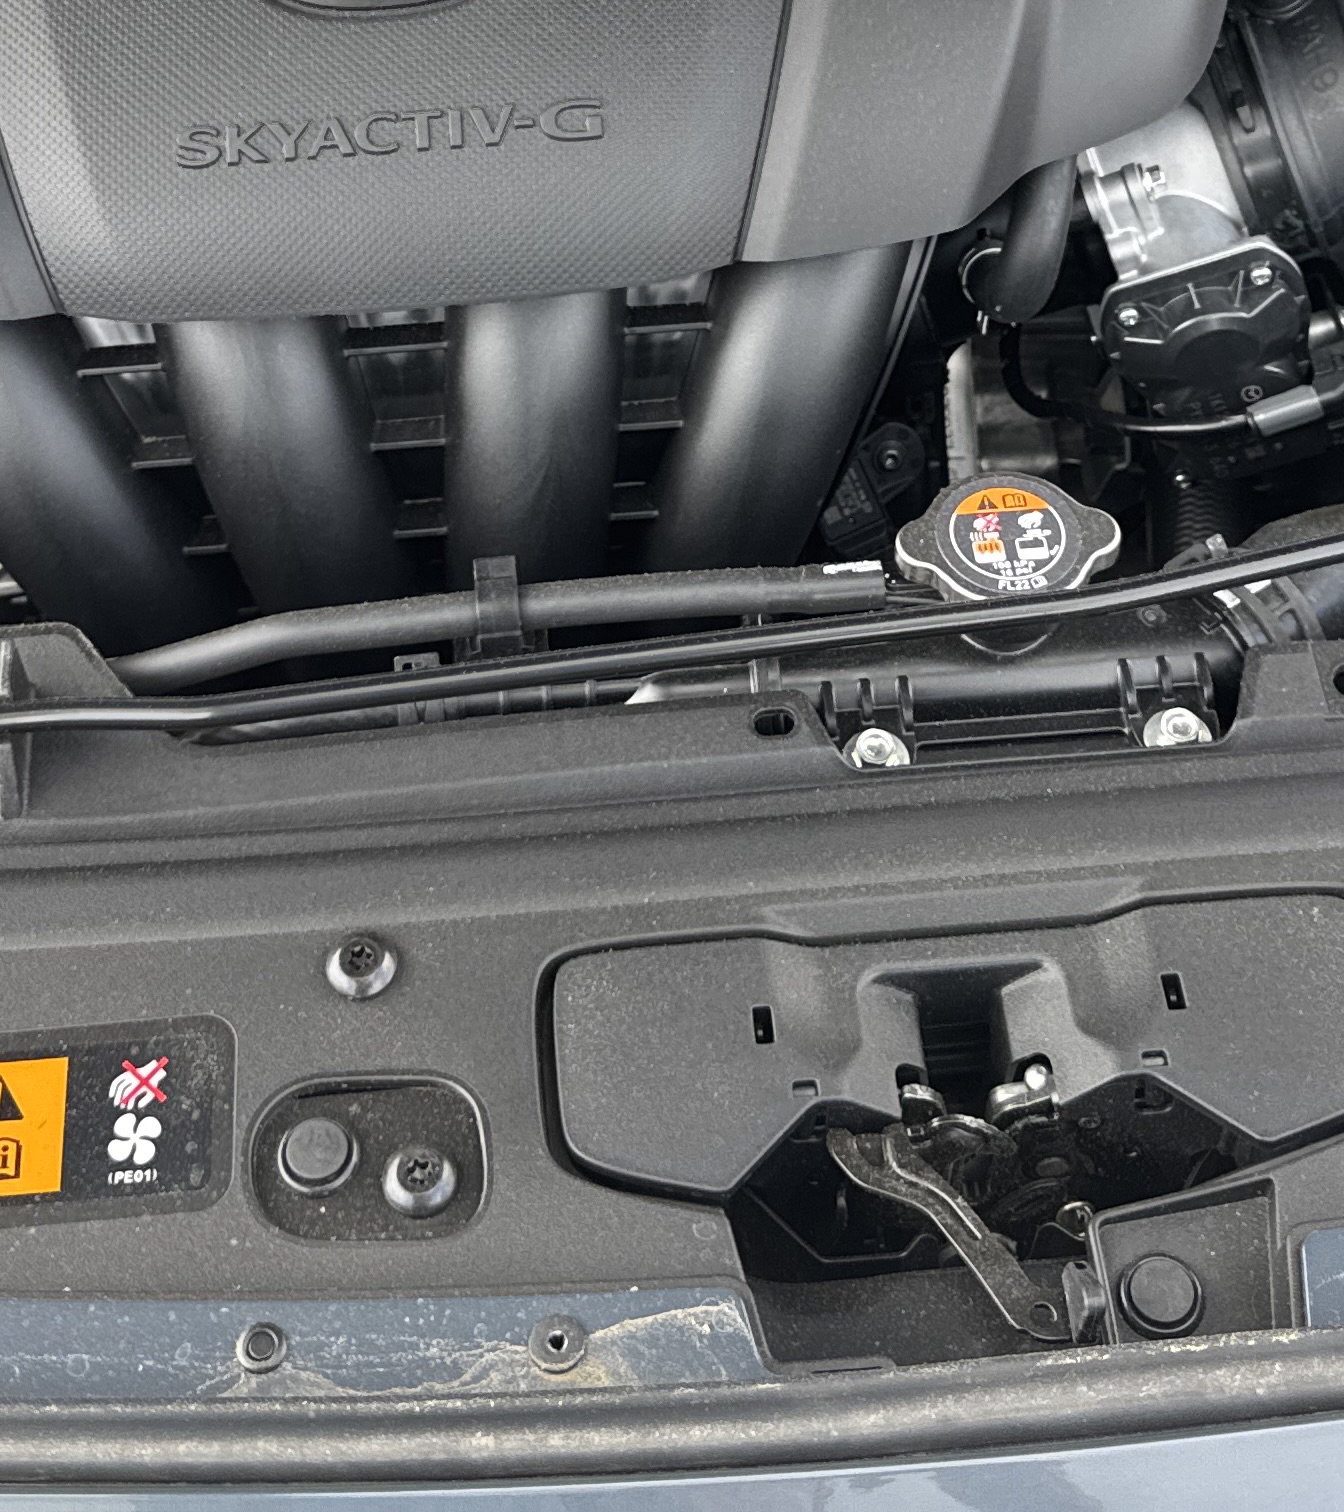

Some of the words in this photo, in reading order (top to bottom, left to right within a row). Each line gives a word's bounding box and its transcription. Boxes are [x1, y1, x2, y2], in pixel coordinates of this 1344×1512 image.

[175, 98, 605, 170] SKYACTIV-G
[997, 579, 1031, 591] FL22
[107, 1168, 158, 1185] (PE01)
